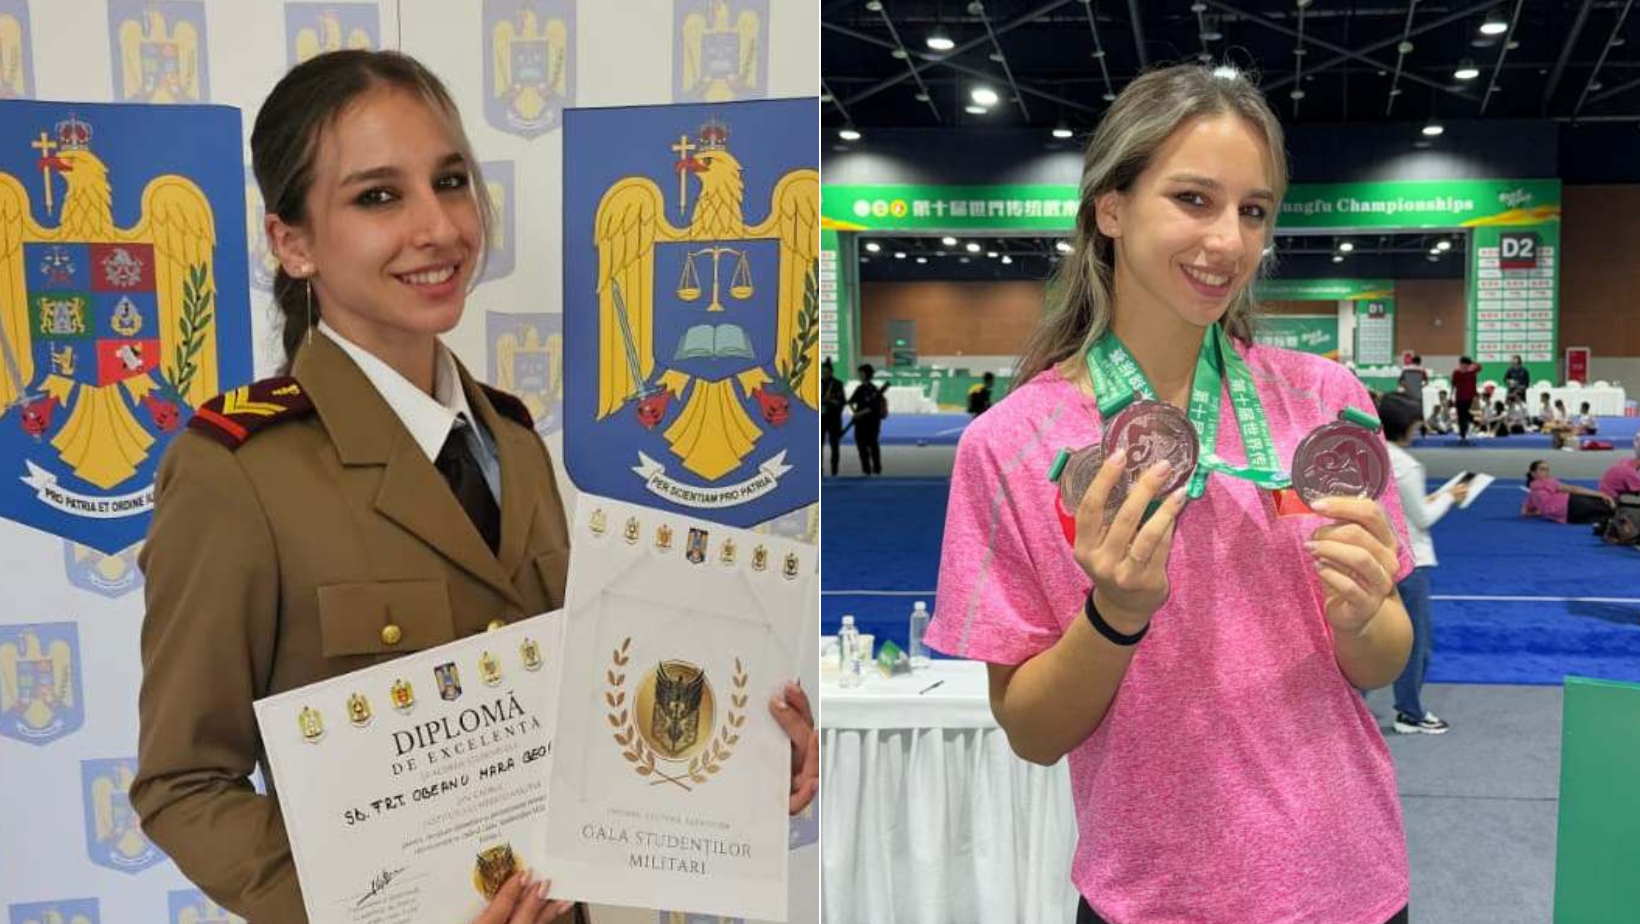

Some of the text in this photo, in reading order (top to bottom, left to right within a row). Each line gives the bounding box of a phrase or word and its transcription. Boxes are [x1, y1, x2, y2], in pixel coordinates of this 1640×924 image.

[1278, 197, 1474, 216] ungfu Championships
[1501, 237, 1534, 258] D2
[44, 487, 64, 505] PRO
[65, 497, 97, 512] PATRIA
[98, 501, 110, 513] ET
[111, 497, 144, 512] ORDINE
[651, 476, 773, 502] PER SCIENTIAM PRO PATRIA
[392, 690, 525, 757] DIPLOMĂ
[391, 757, 417, 776] DE
[412, 774, 470, 802] OBEANU
[479, 757, 516, 780] MARA
[522, 740, 552, 764] GEO
[582, 823, 630, 844] GALA
[629, 853, 706, 875] MILITARI
